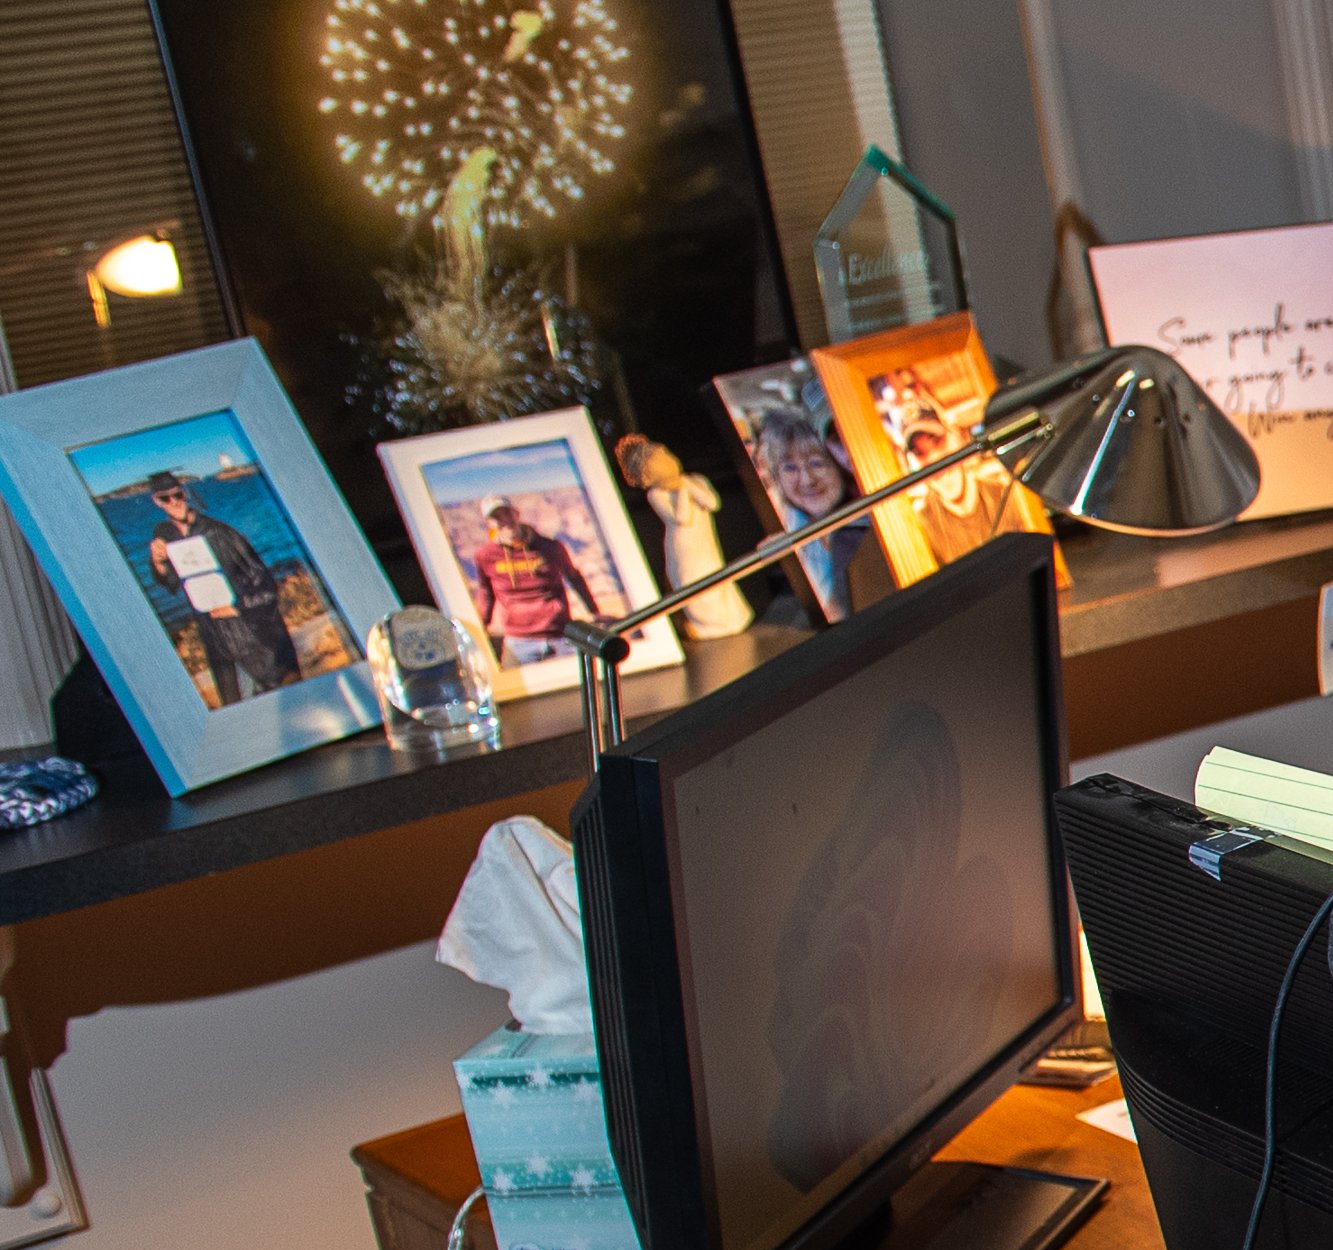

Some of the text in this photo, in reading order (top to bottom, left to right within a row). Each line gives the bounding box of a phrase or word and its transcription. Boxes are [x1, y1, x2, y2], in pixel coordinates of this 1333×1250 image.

[1157, 316, 1212, 357] Some
[1228, 302, 1294, 360] people
[1225, 369, 1286, 411] going
[1289, 346, 1315, 380] to
